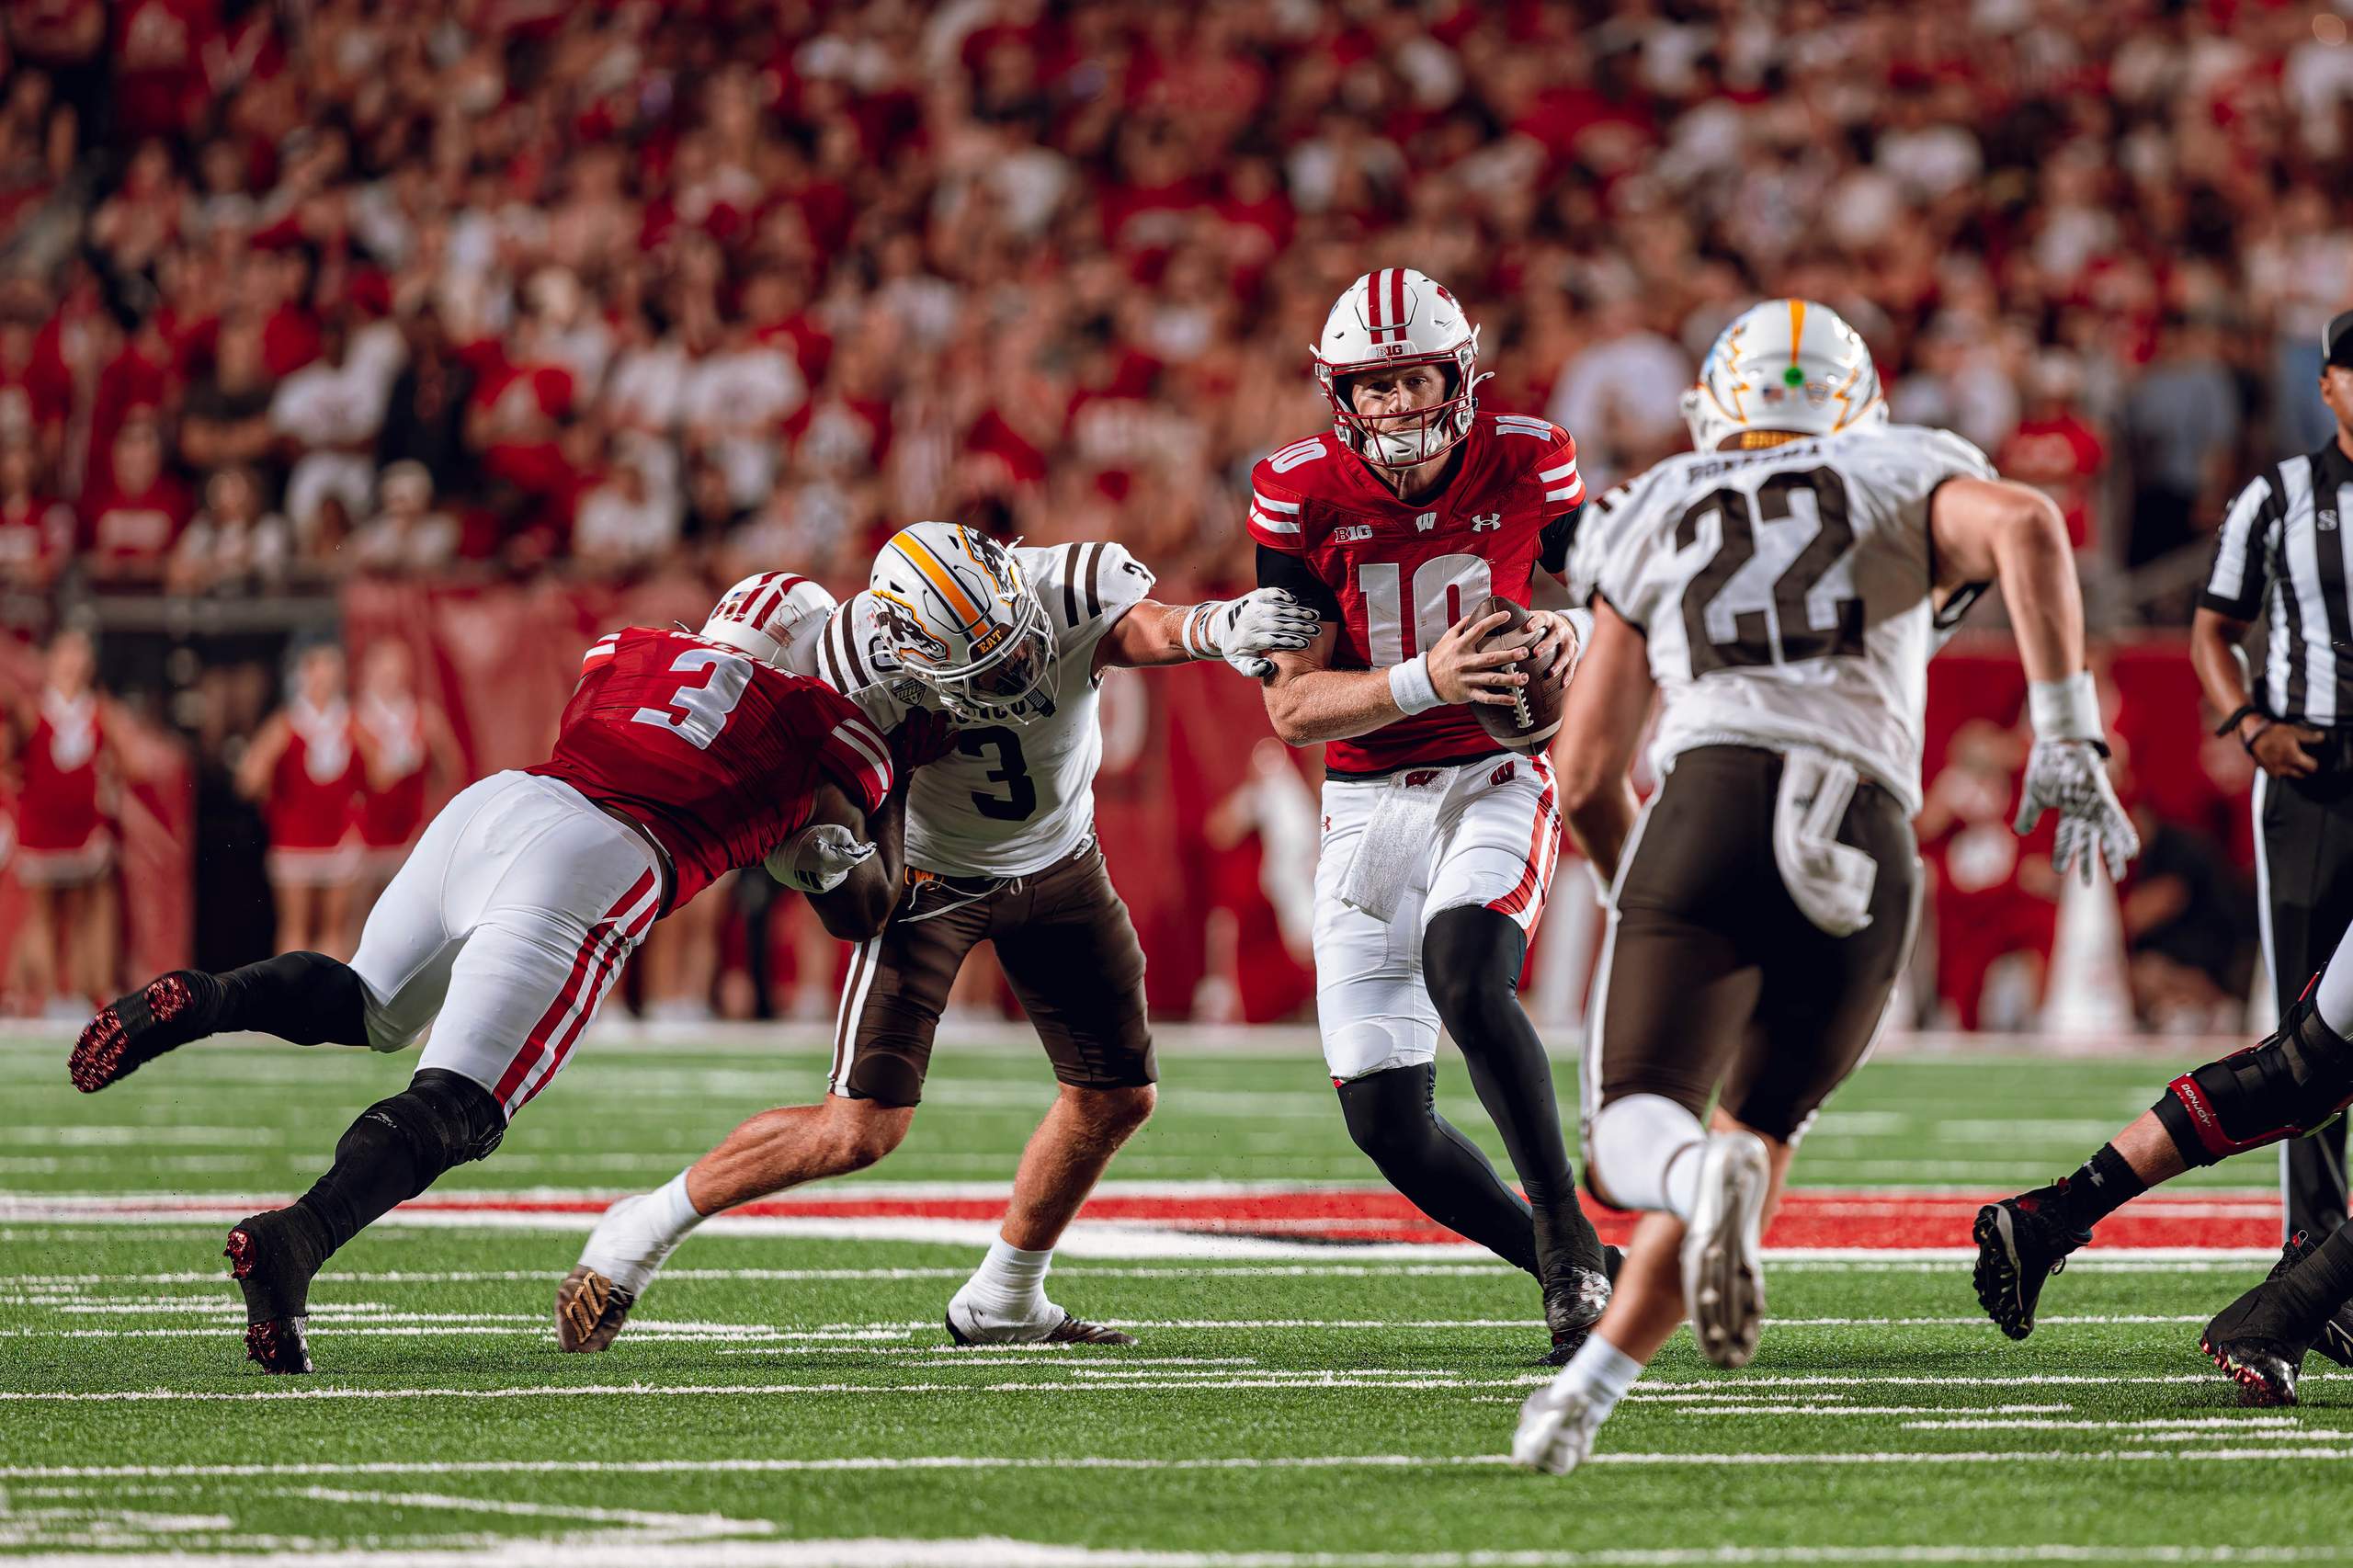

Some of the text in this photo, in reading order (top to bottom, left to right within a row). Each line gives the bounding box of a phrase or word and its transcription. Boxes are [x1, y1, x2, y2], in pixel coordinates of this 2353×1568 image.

[1495, 415, 1552, 441] 10
[1267, 437, 1327, 474] 10
[1415, 512, 1437, 533] W
[1676, 466, 1865, 680] 22
[1358, 554, 1492, 674] 10
[977, 629, 1002, 653] EAT
[631, 648, 754, 750] 3
[959, 725, 1037, 822] 3
[2180, 1084, 2211, 1127] DONJOY
